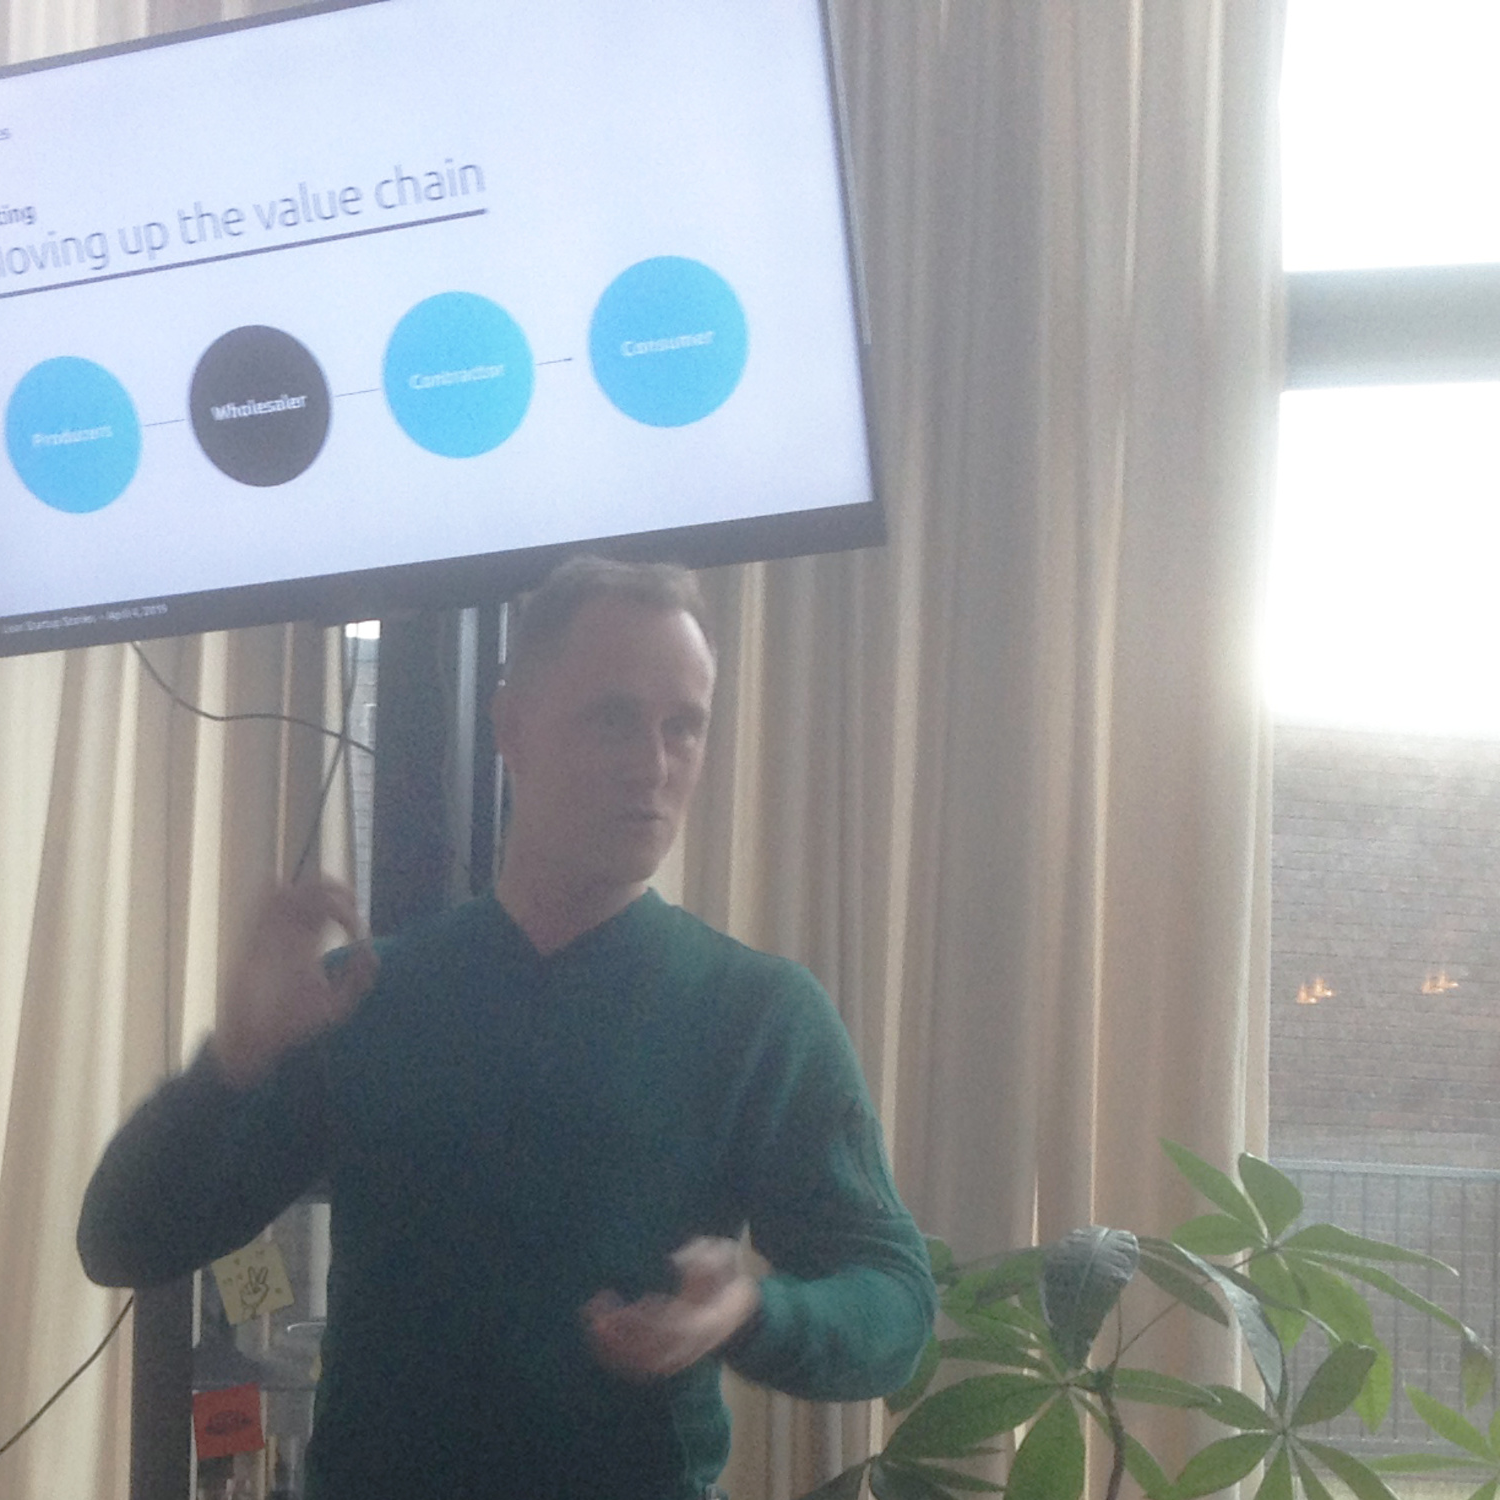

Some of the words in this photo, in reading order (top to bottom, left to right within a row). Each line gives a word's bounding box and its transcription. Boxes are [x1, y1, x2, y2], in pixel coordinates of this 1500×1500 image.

[116, 217, 170, 261] up
[175, 200, 245, 247] the
[253, 180, 364, 232] value
[373, 156, 487, 211] chain
[209, 393, 308, 421] Wholesaler
